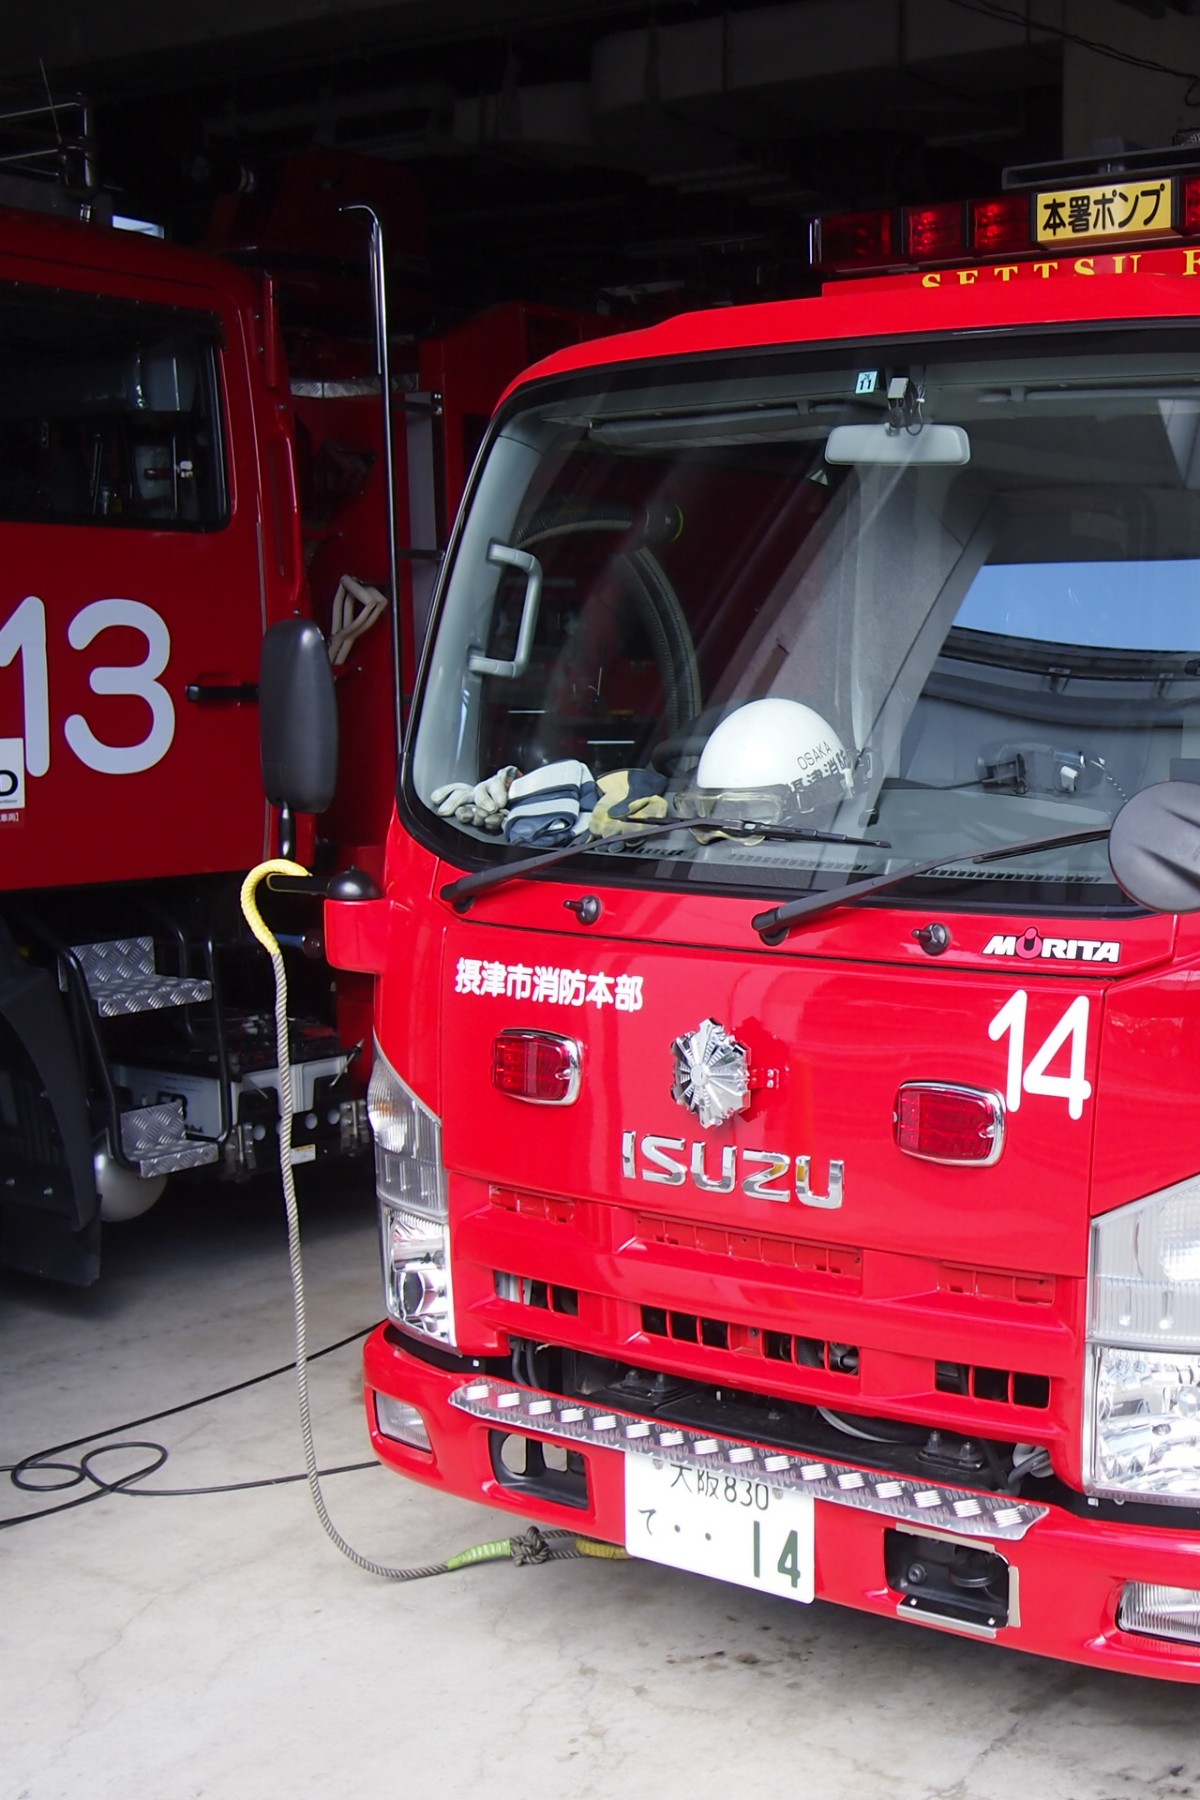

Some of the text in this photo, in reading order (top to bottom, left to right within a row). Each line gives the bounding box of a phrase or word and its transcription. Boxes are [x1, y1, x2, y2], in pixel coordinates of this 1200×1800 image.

[1042, 184, 1165, 236] 本署ポンプ
[860, 380, 871, 391] 11
[0, 595, 175, 777] 13
[797, 741, 832, 771] OSAKA
[982, 927, 1121, 963] MORITA
[455, 957, 644, 1012] 摂津市消防本部
[988, 989, 1092, 1120] 14
[622, 1129, 846, 1209] ISUZU
[637, 1508, 657, 1535] て
[753, 1520, 801, 1588] 14
